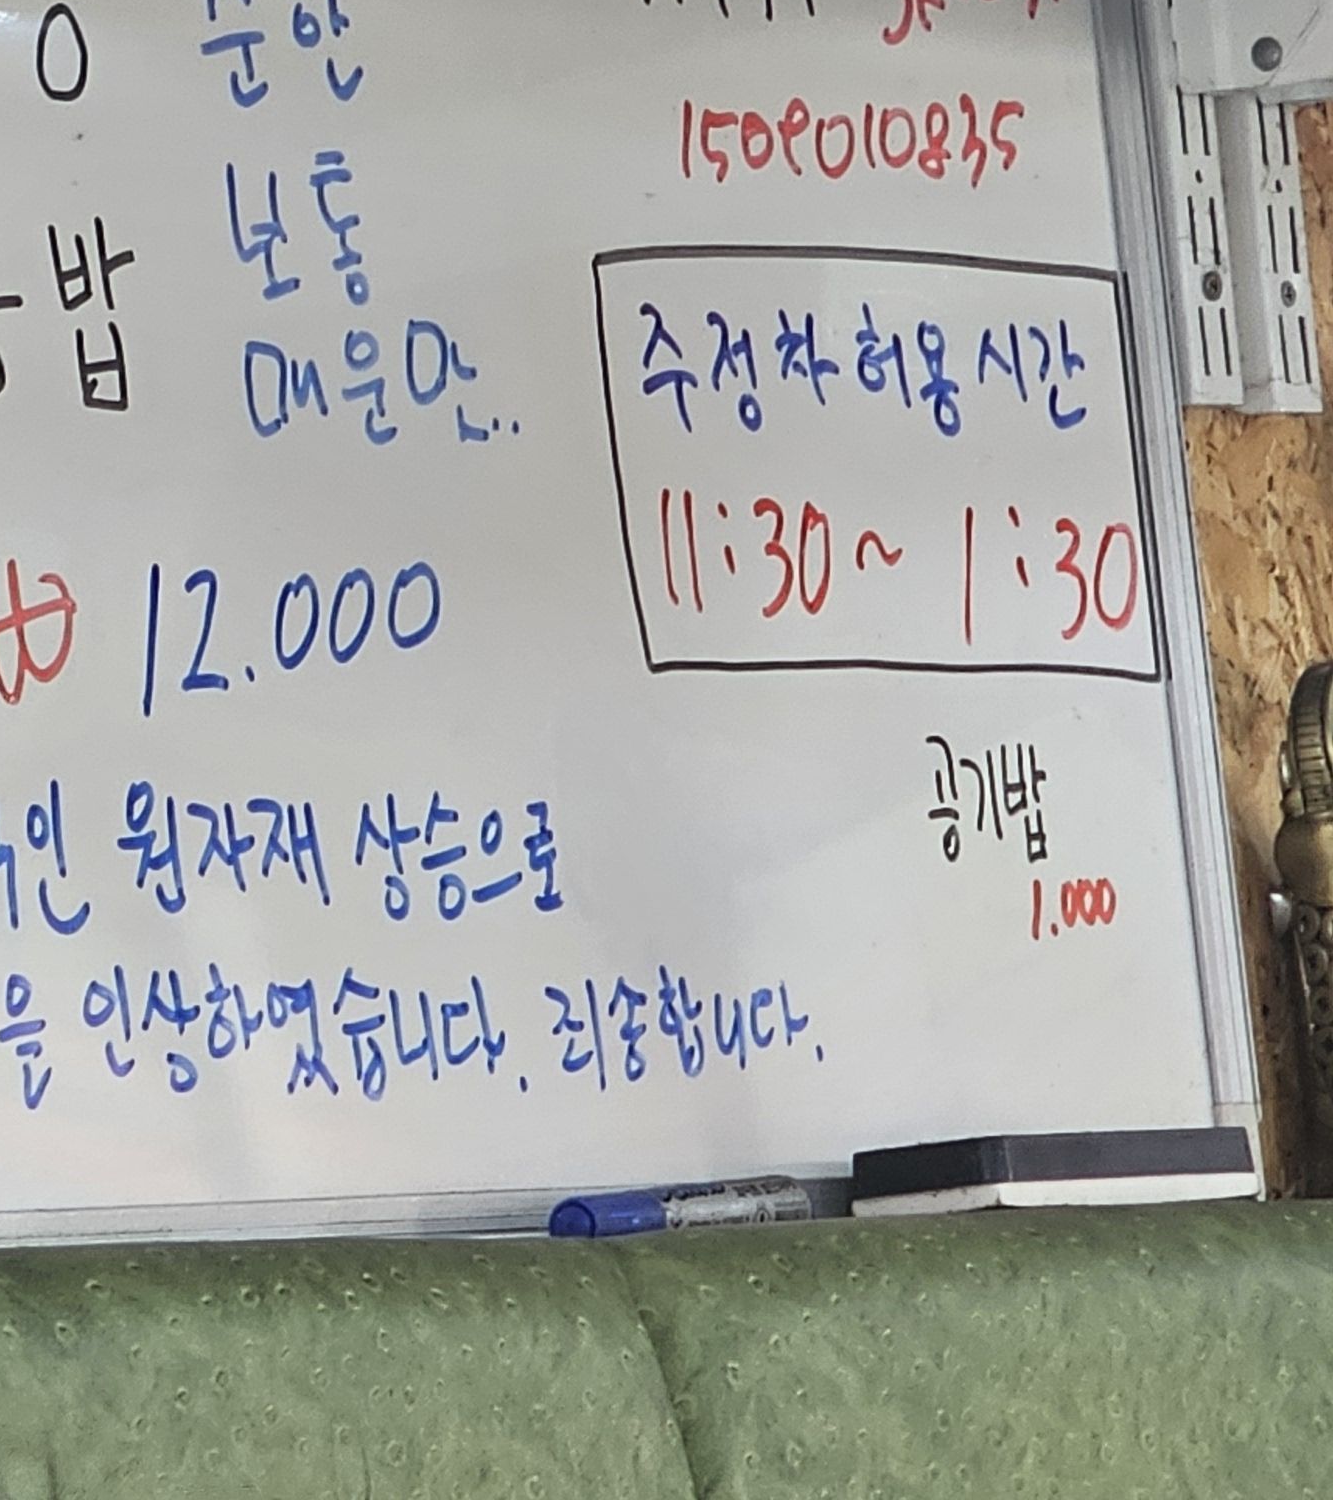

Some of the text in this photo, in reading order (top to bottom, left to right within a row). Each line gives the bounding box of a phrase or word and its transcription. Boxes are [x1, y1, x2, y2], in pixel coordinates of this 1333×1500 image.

[226, 151, 368, 305] 보통
[143, 562, 440, 717] 12.000
[117, 781, 330, 913] 원자재
[355, 791, 563, 921] 상승으로
[926, 736, 1047, 863] 공기밥
[1032, 878, 1116, 940] 1.000
